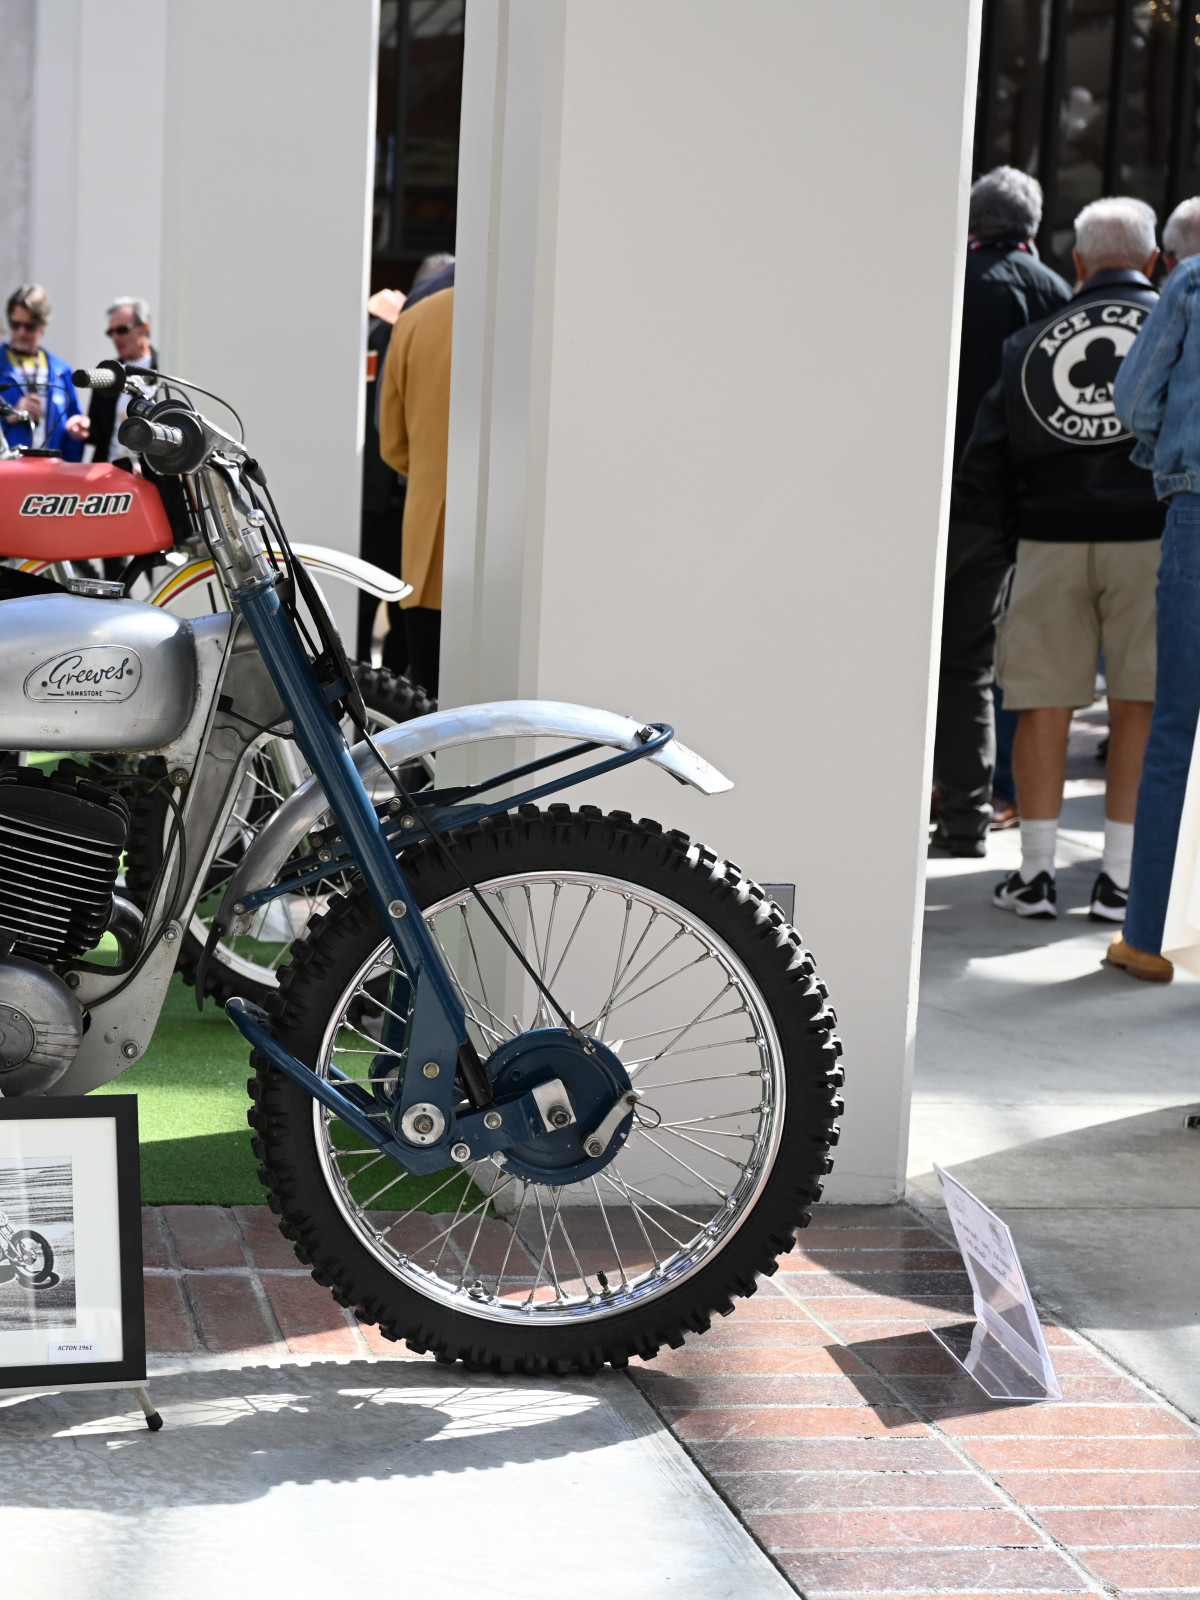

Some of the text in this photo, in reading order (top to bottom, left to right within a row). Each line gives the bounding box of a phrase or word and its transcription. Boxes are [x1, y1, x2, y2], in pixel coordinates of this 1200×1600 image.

[1040, 305, 1143, 357] ACE CA
[1076, 387, 1109, 405] AC
[1048, 405, 1122, 438] LOND
[19, 492, 133, 517] can-am
[48, 655, 129, 689] Greeves
